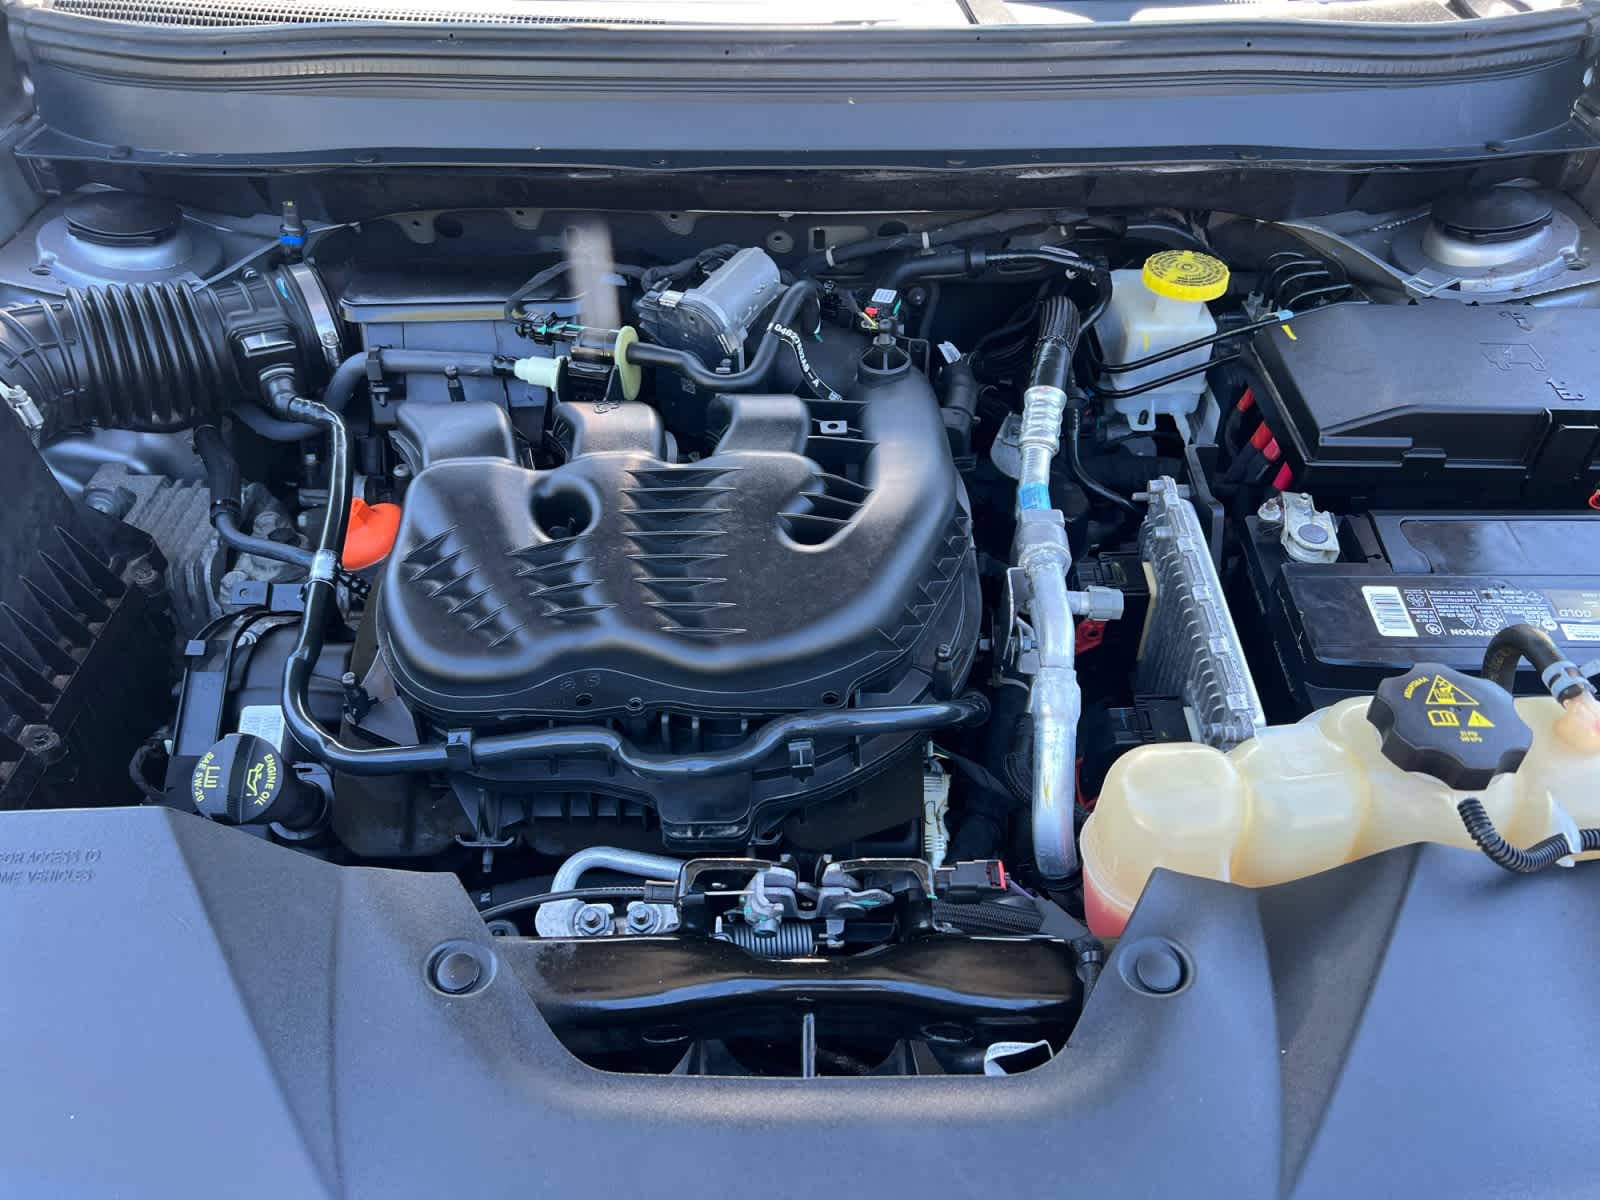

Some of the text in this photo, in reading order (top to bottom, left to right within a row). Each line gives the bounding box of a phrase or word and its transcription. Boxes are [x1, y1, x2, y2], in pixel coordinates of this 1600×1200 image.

[1559, 608, 1592, 617] GOLD
[193, 771, 206, 803] 5W-20
[254, 753, 277, 806] ENGINE OIL
